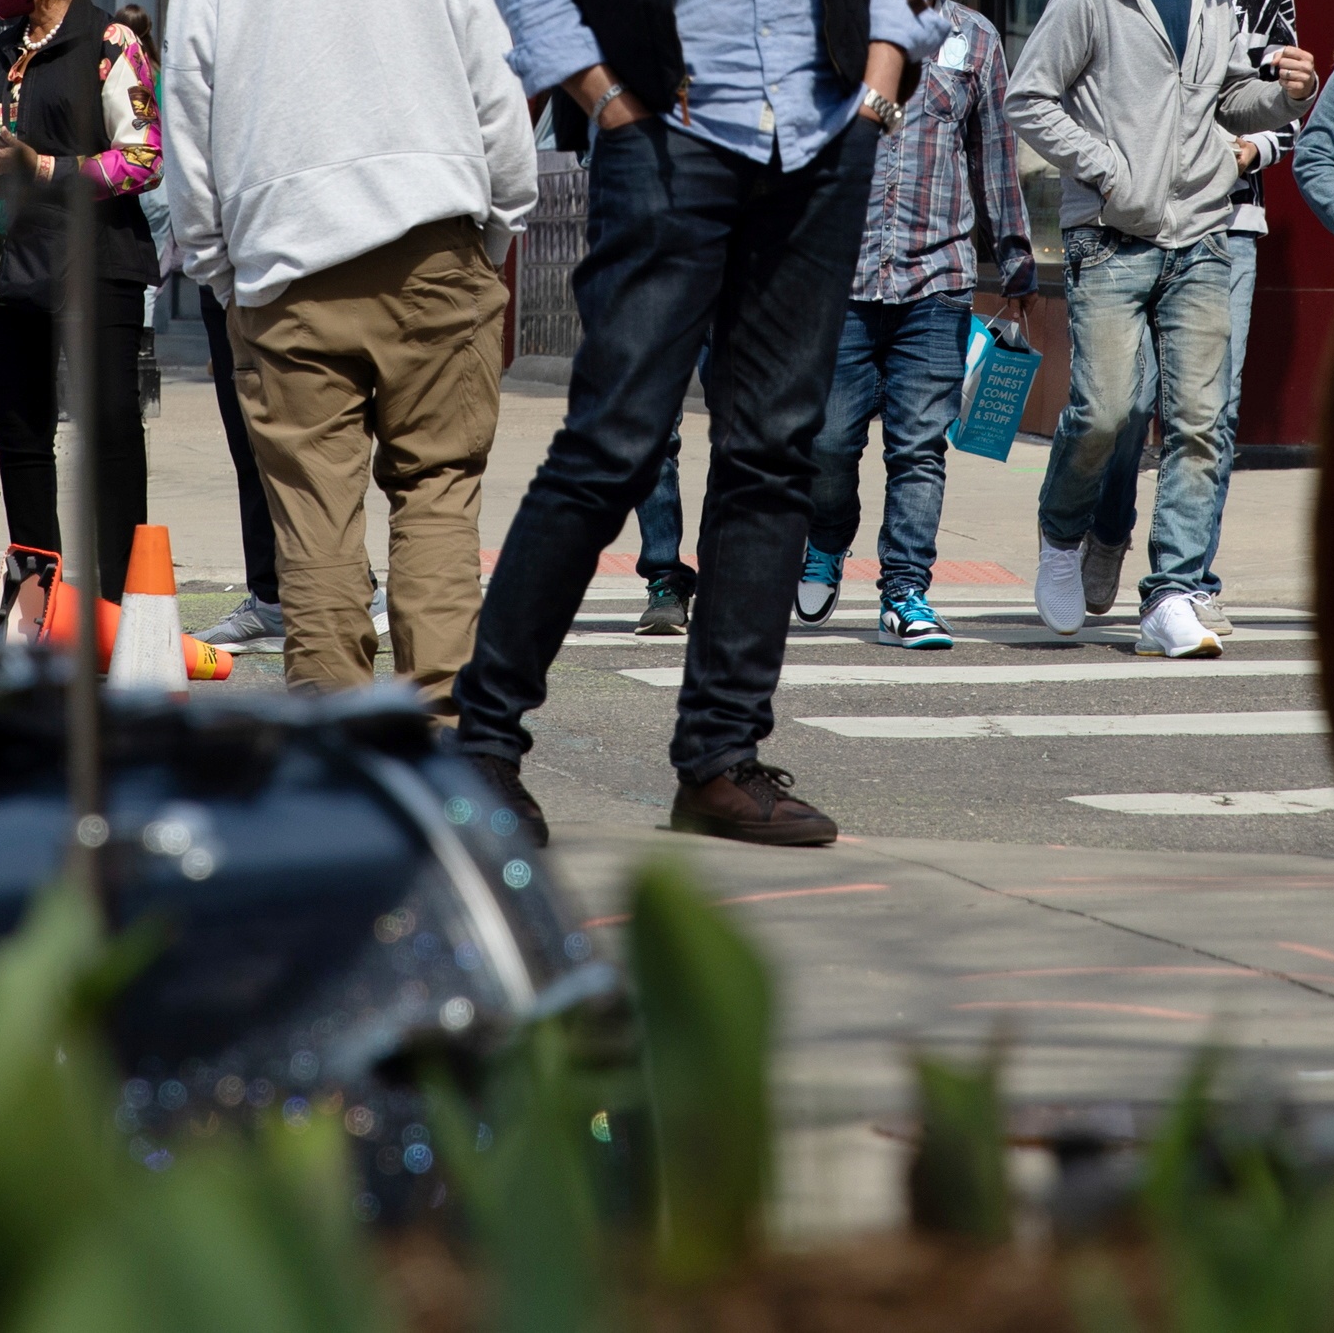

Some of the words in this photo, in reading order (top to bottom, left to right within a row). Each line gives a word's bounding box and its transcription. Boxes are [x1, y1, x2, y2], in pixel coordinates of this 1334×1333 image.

[991, 363, 1028, 377] EARTH'S
[987, 375, 1024, 390] FINEST
[982, 387, 1020, 403] COMIC
[978, 399, 1015, 415] BOOKS
[974, 410, 982, 420] &
[983, 412, 1011, 425] STUFF
